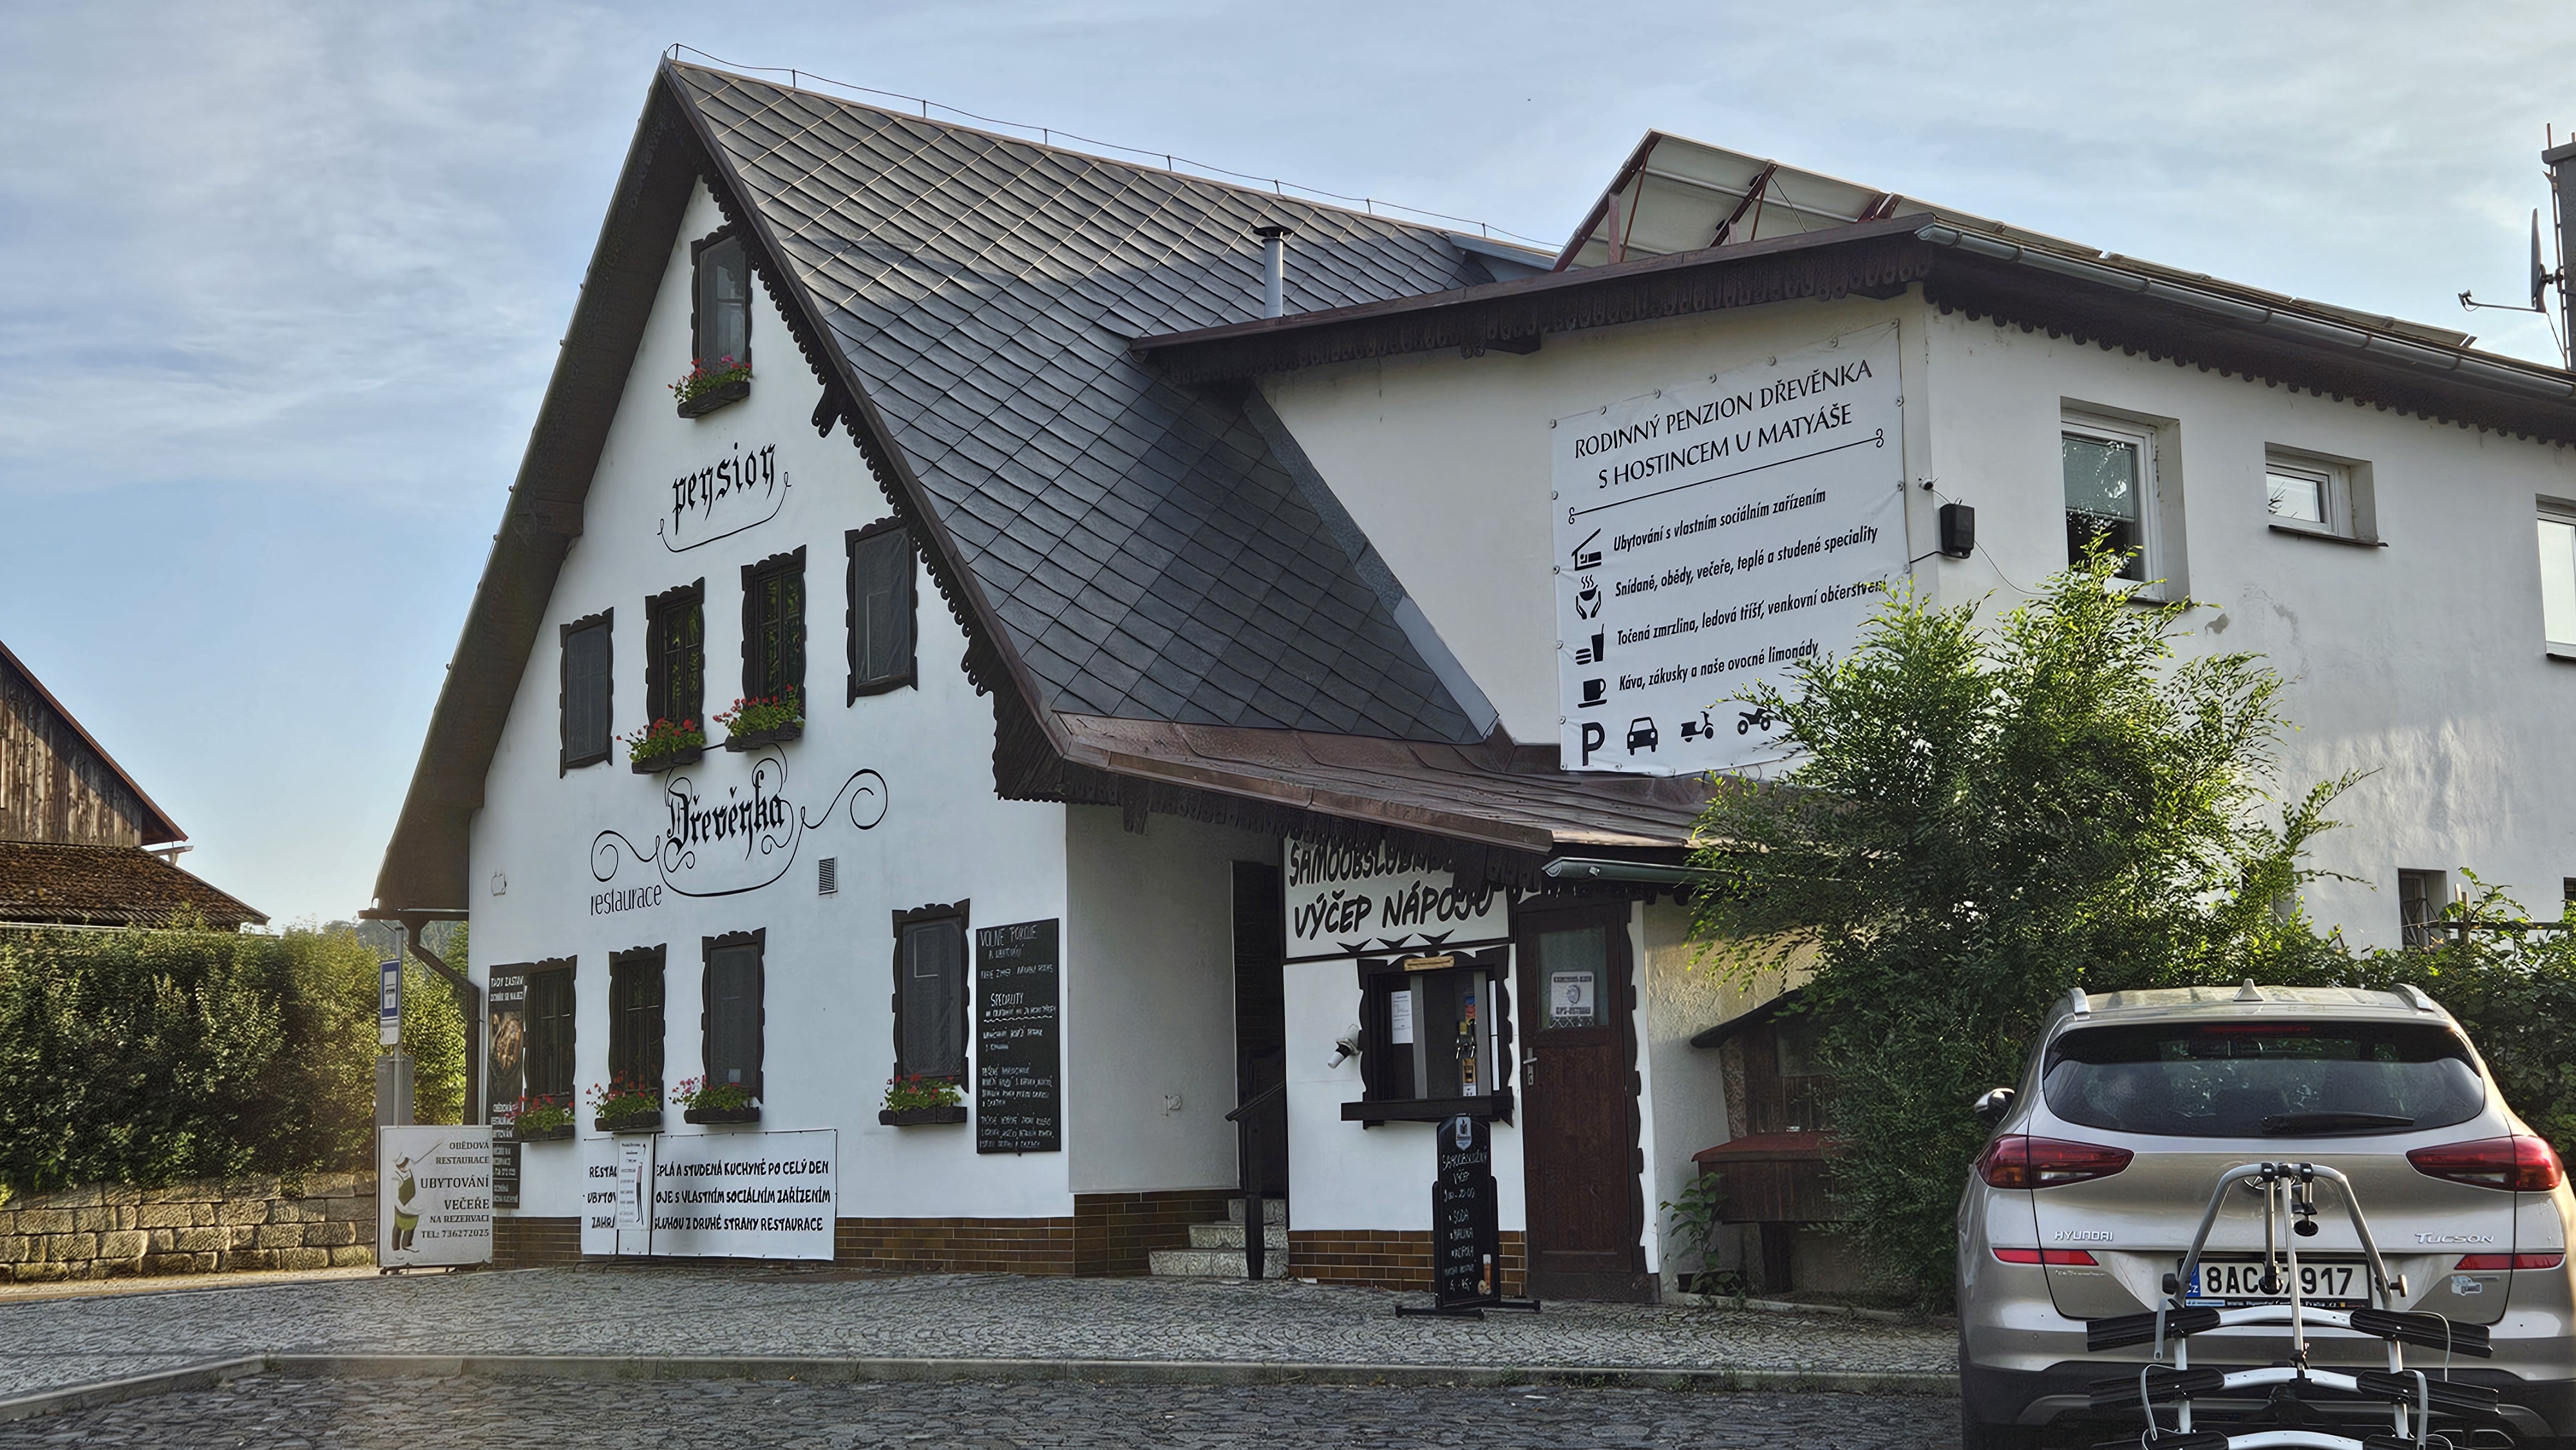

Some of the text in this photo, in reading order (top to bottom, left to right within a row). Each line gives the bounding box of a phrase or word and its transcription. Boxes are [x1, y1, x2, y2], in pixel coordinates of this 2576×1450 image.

[1575, 359, 1872, 458] RODINNÝ PENZION DŘEVĚNKA
[1598, 402, 1853, 489] S HOSTINCEM U MATYÁŠE
[673, 442, 776, 535] pension
[1614, 488, 1826, 553] Ubytování s vlastním sociálním zařízením
[1615, 525, 1879, 597] Snídaně, obědy, večeře, teplé a studené speciality
[1617, 625, 1651, 645] Točená
[1653, 615, 1700, 639] zmrzlina,
[1701, 605, 1738, 629] ledová
[1768, 587, 1818, 614] venkovní
[1618, 637, 1819, 692] Káva, zákusky a naše ovocné limonády
[1582, 722, 1605, 767] P
[666, 770, 786, 860] Dřevěnka
[591, 883, 662, 916] restaurace
[1294, 889, 1372, 941] VÝČEP
[421, 1174, 489, 1189] UBYTOVÁNÍ
[435, 1156, 489, 1165] RESTAURACE
[676, 1163, 682, 1176] A
[683, 1160, 722, 1176] STUDENÁ
[768, 1162, 781, 1175] PO
[782, 1159, 807, 1175] CELÝ
[809, 1161, 829, 1174] DEN
[444, 1196, 489, 1210] VEČEŘE
[656, 1191, 673, 1203] OJE
[681, 1187, 724, 1203] VLASTNÍM
[726, 1187, 775, 1203] SOCIÁLNÍM
[777, 1185, 830, 1203] ZAŘÍZENÍM
[693, 1214, 721, 1230] DRUHÉ
[724, 1217, 759, 1230] STRANY
[761, 1217, 824, 1231] RESTAURACE
[2055, 1230, 2113, 1241] HYUNDAI
[2206, 1266, 2259, 1294] 8AC
